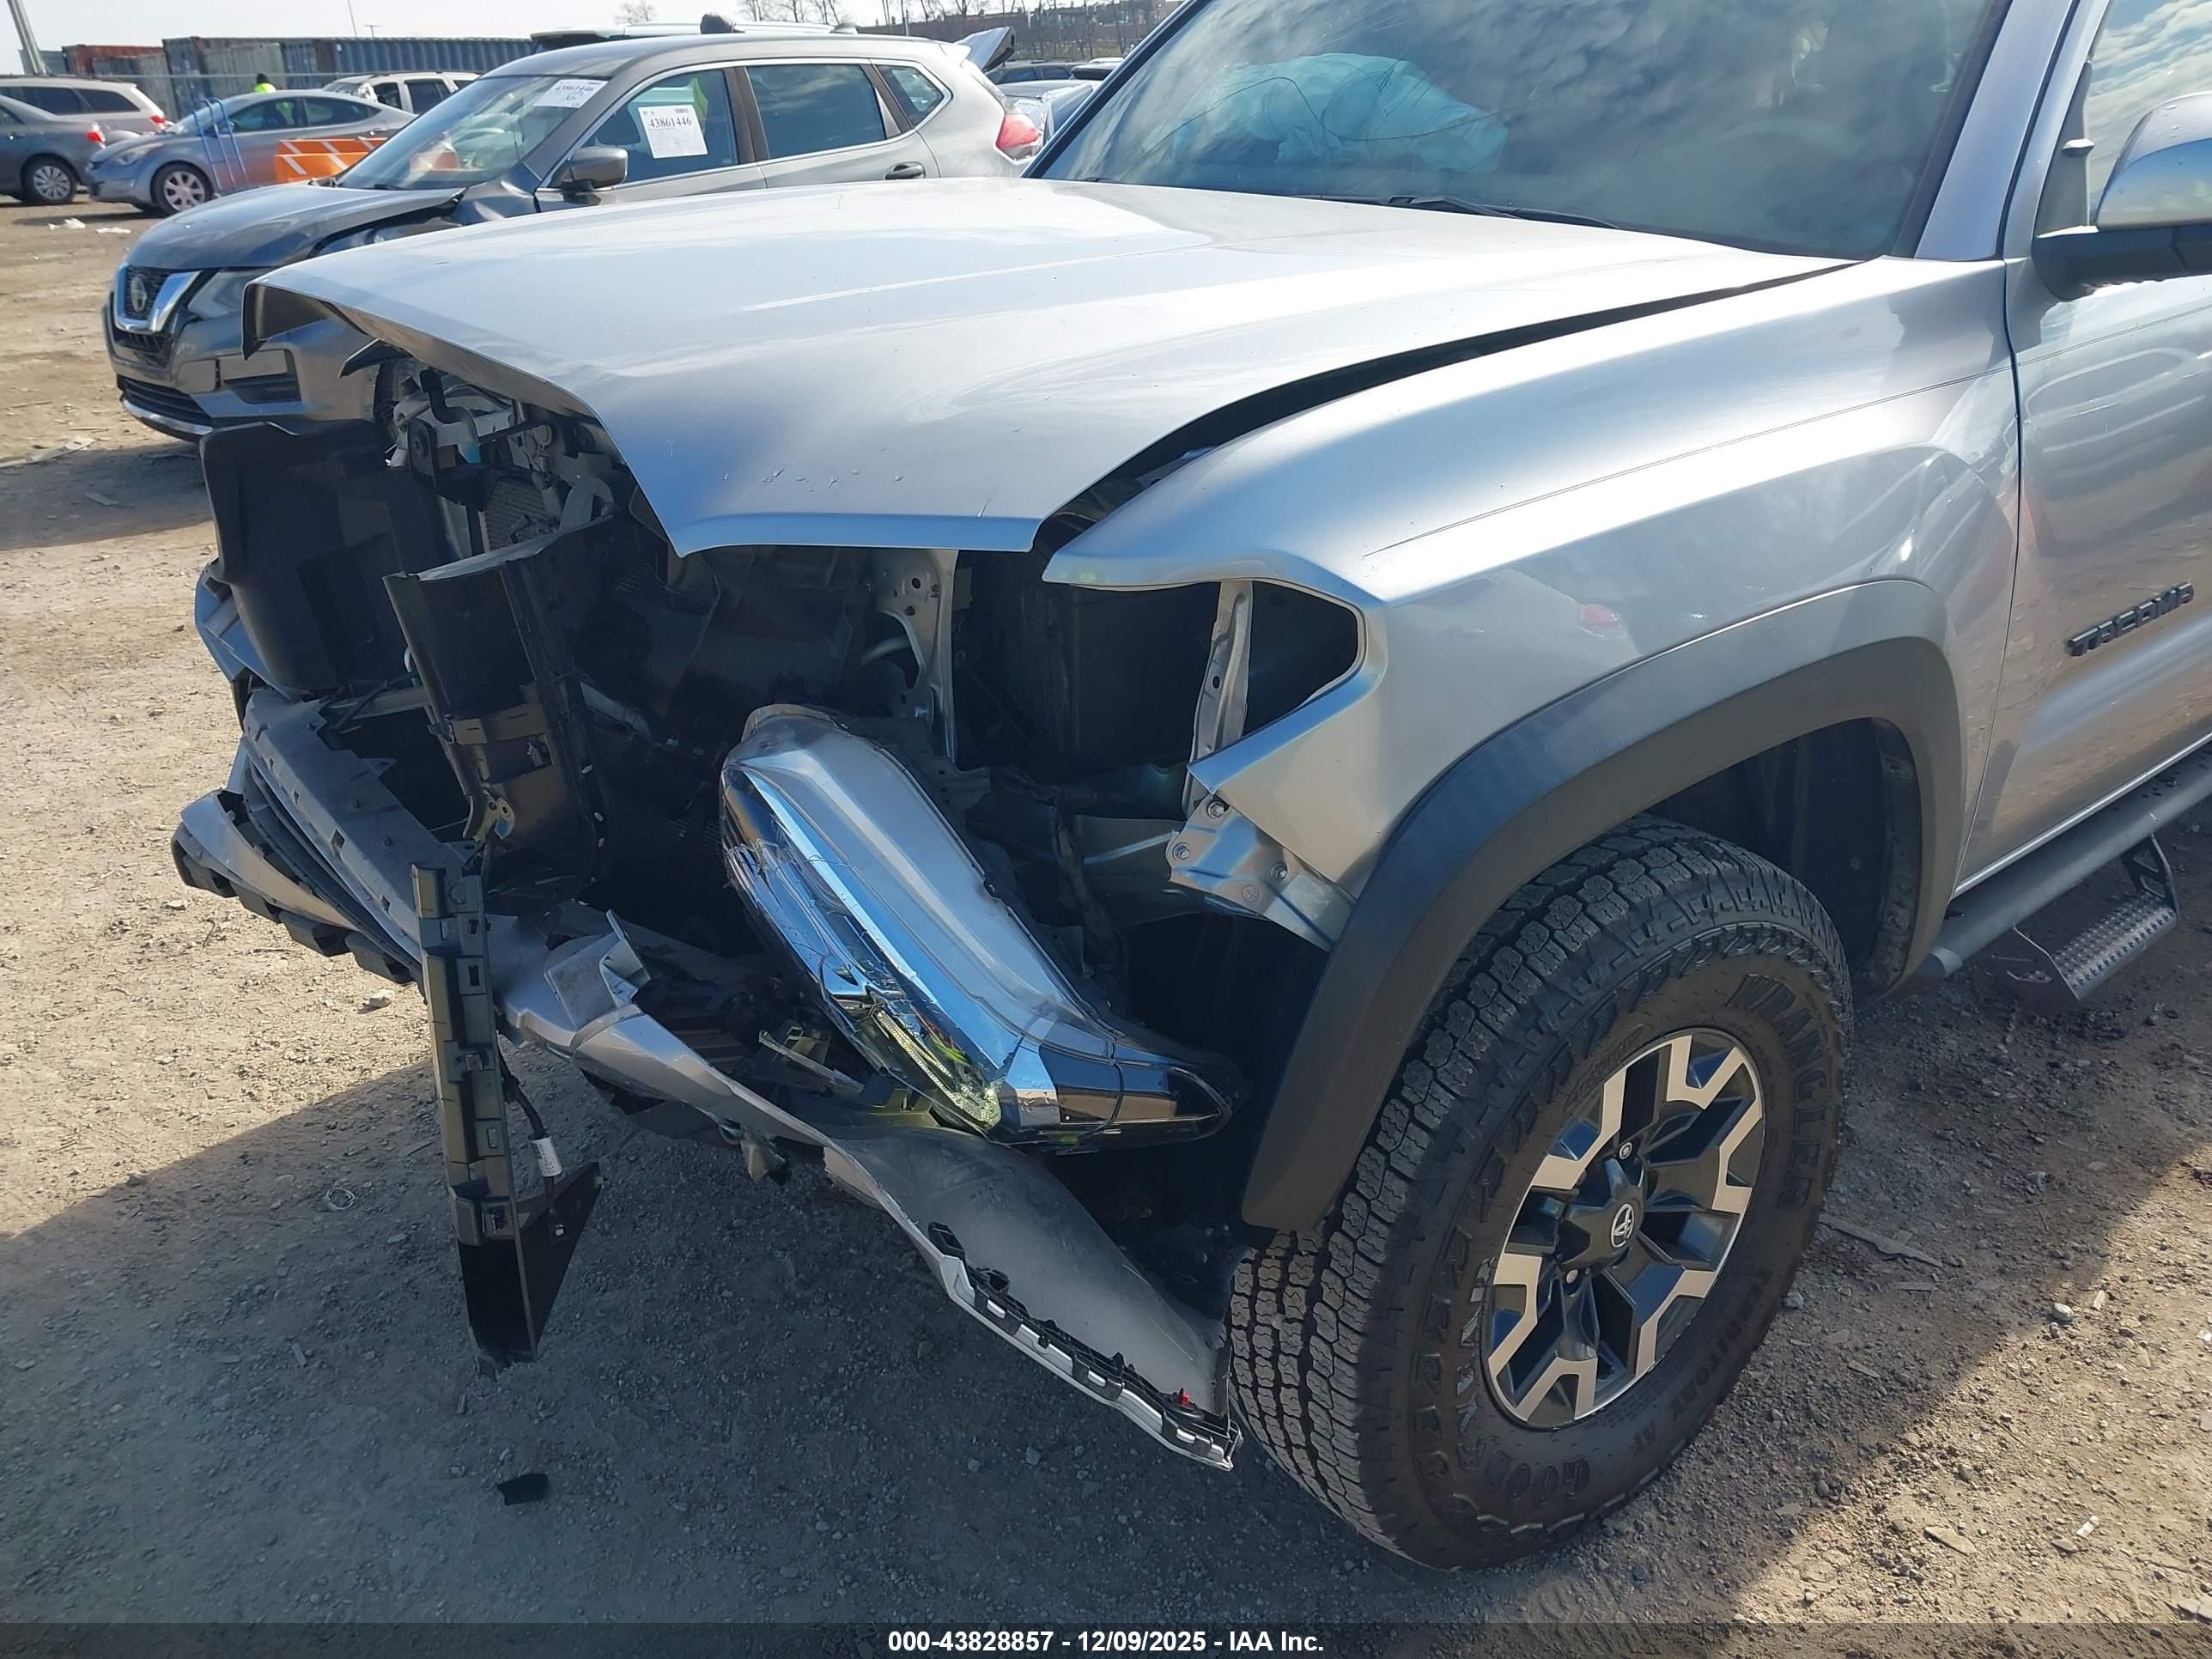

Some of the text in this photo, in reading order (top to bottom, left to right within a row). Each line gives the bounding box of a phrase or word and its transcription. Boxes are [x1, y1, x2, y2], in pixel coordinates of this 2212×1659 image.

[648, 116, 693, 129] 43861446
[2067, 581, 2195, 657] TACOMA
[1725, 972, 1828, 1210] WRANGLER
